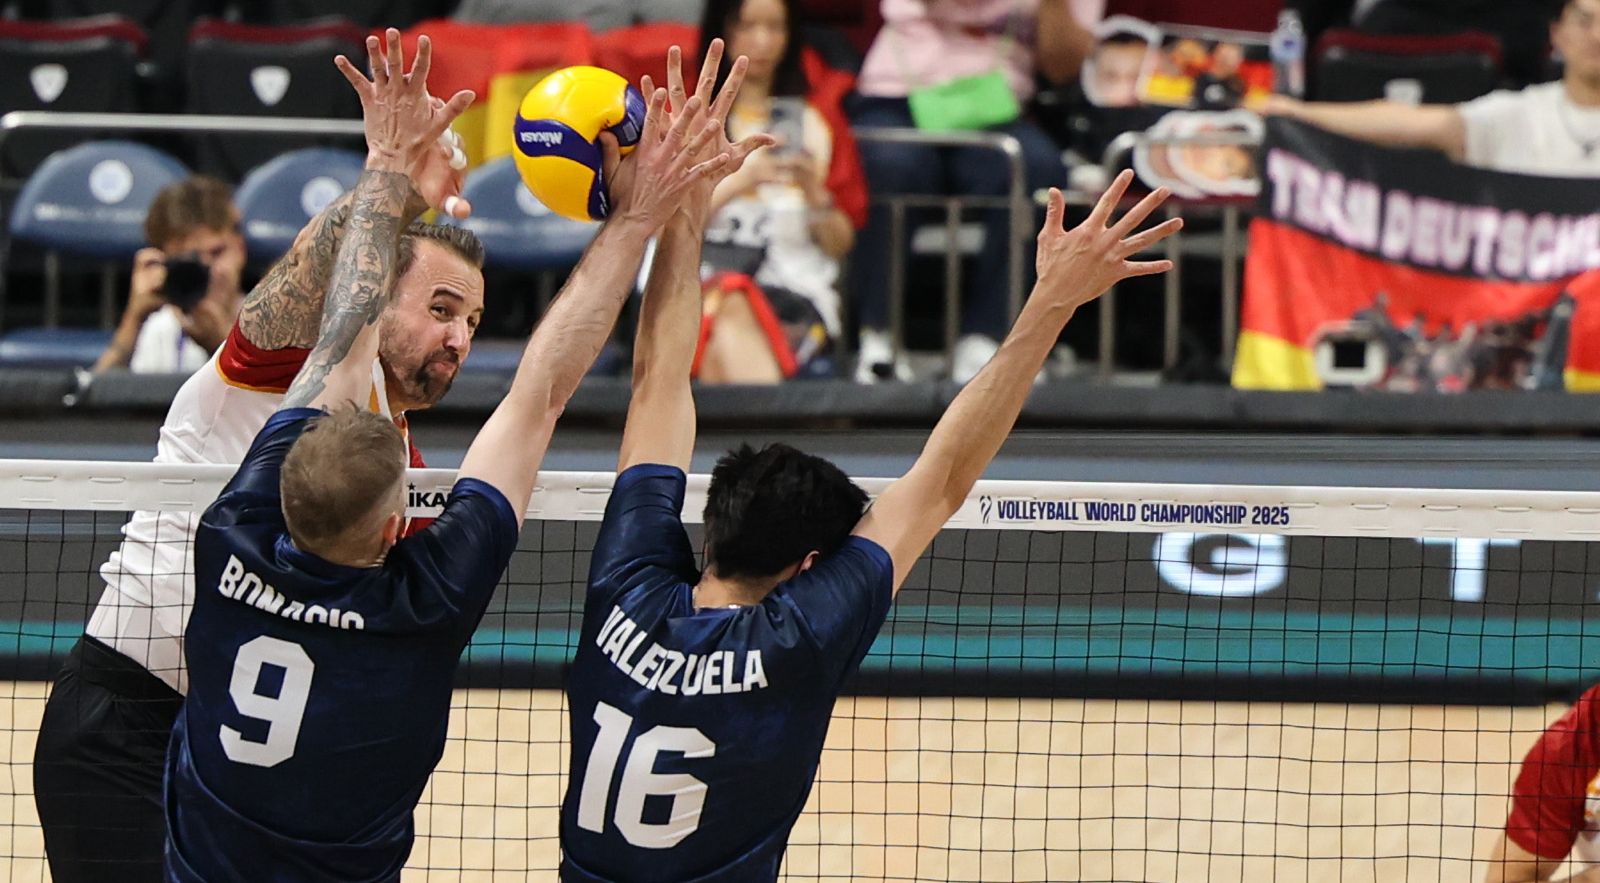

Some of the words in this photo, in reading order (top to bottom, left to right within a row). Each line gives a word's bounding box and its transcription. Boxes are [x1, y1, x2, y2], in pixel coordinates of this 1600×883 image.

[998, 500, 1079, 521] VOLLEYBALL
[1084, 501, 1136, 522] WORLD
[1141, 503, 1247, 525] CHAMPIONSHIP
[1251, 505, 1290, 526] 2025
[218, 634, 316, 769] 9
[595, 604, 769, 697] VALEZUELA
[576, 700, 717, 850] 16
